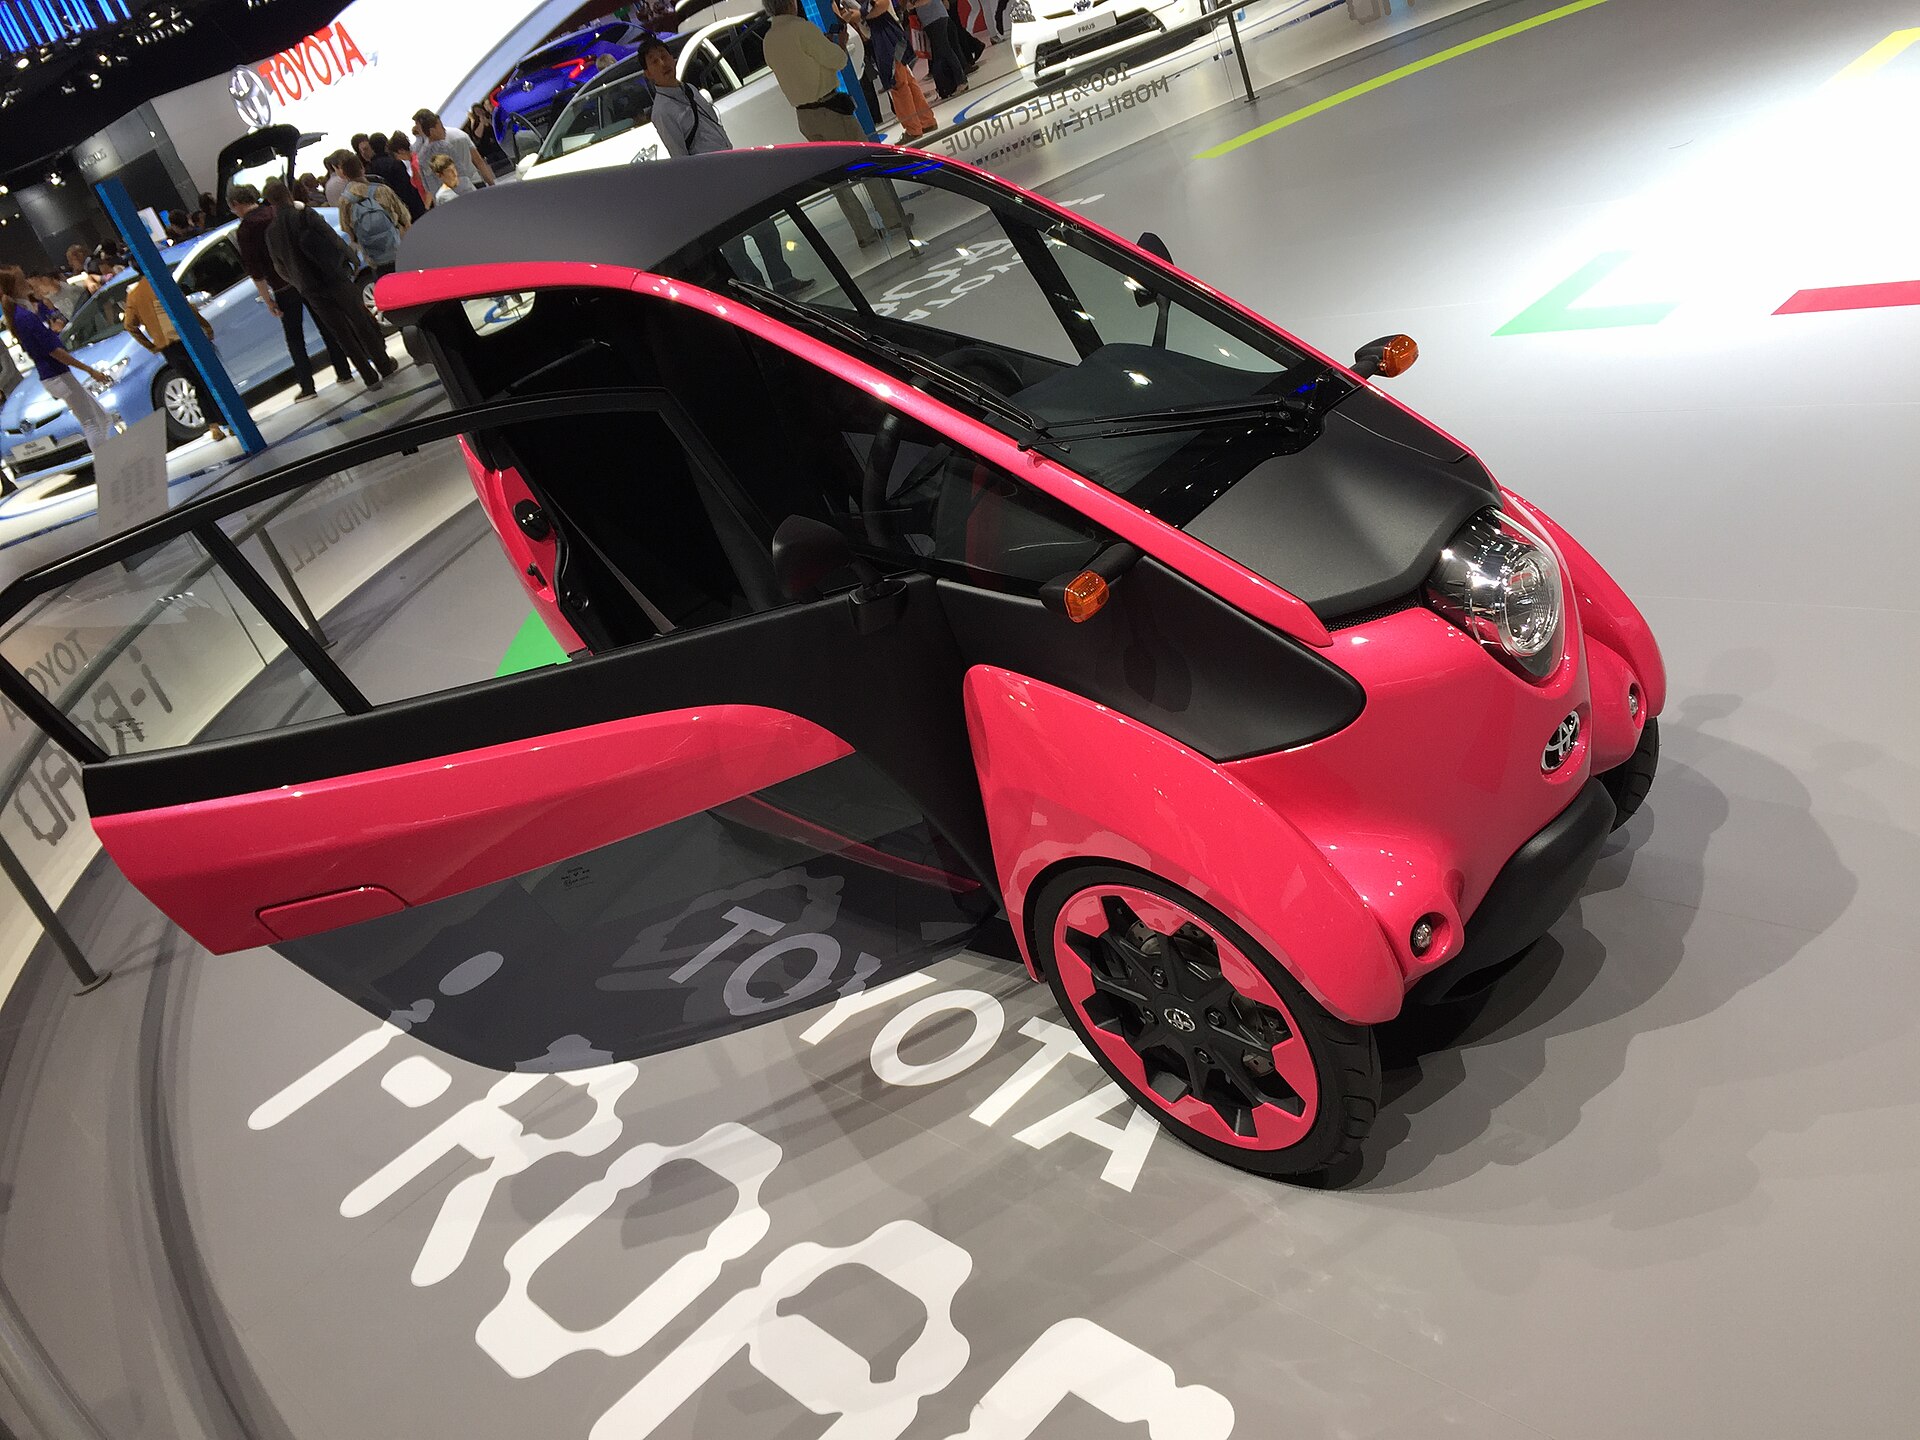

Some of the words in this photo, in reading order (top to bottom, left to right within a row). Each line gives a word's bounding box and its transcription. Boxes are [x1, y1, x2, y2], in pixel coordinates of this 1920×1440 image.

[256, 20, 368, 107] TOYOTA
[1077, 22, 1096, 33] PRIUS
[668, 906, 1160, 1192] TOYOTA
